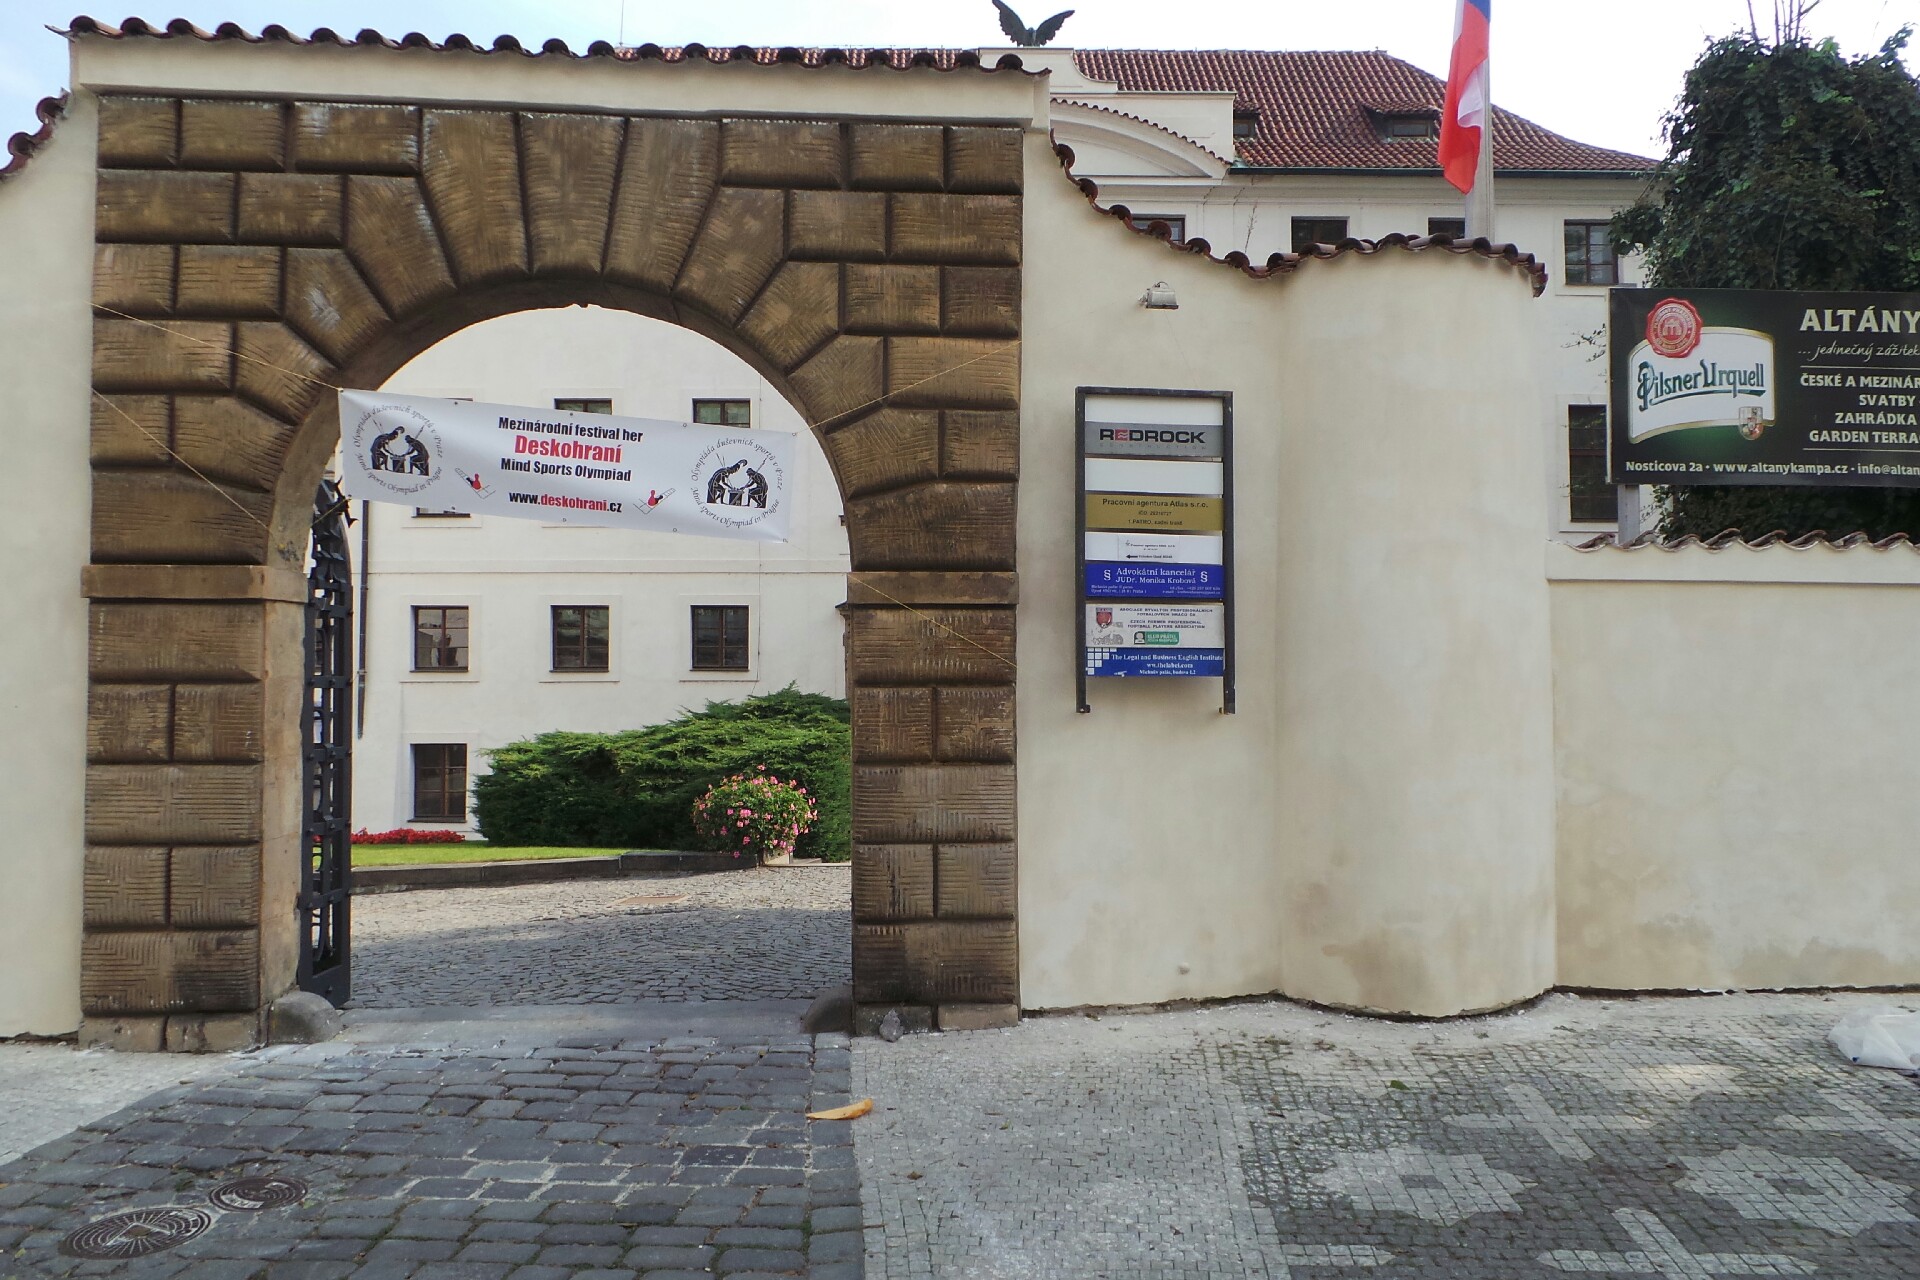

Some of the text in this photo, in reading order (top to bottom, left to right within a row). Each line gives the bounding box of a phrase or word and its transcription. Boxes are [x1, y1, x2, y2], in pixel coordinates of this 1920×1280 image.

[1800, 306, 1920, 334] ALTÁNY
[1637, 359, 1764, 412] Pilsner Urquell
[1800, 372, 1842, 387] ČESKÉ
[1845, 376, 1856, 388] A
[1859, 394, 1916, 407] SVATBY
[1835, 411, 1918, 425] ZAHRÁDKA
[498, 417, 643, 442] Mezinárodní festival her
[1100, 428, 1205, 444] REDROCK
[1809, 430, 1920, 444] GARDEN TERRA
[515, 435, 622, 463] Deskohraní
[500, 458, 631, 481] Mind Sports Olympiad
[1626, 460, 1686, 472] Nosticova
[1689, 462, 1703, 472] 2a
[1713, 462, 1848, 476] www.altanykampa.cz
[509, 492, 622, 513] www.deskohrani.cz
[1102, 498, 1135, 506] Pracovní
[1116, 568, 1158, 576] Advokátní
